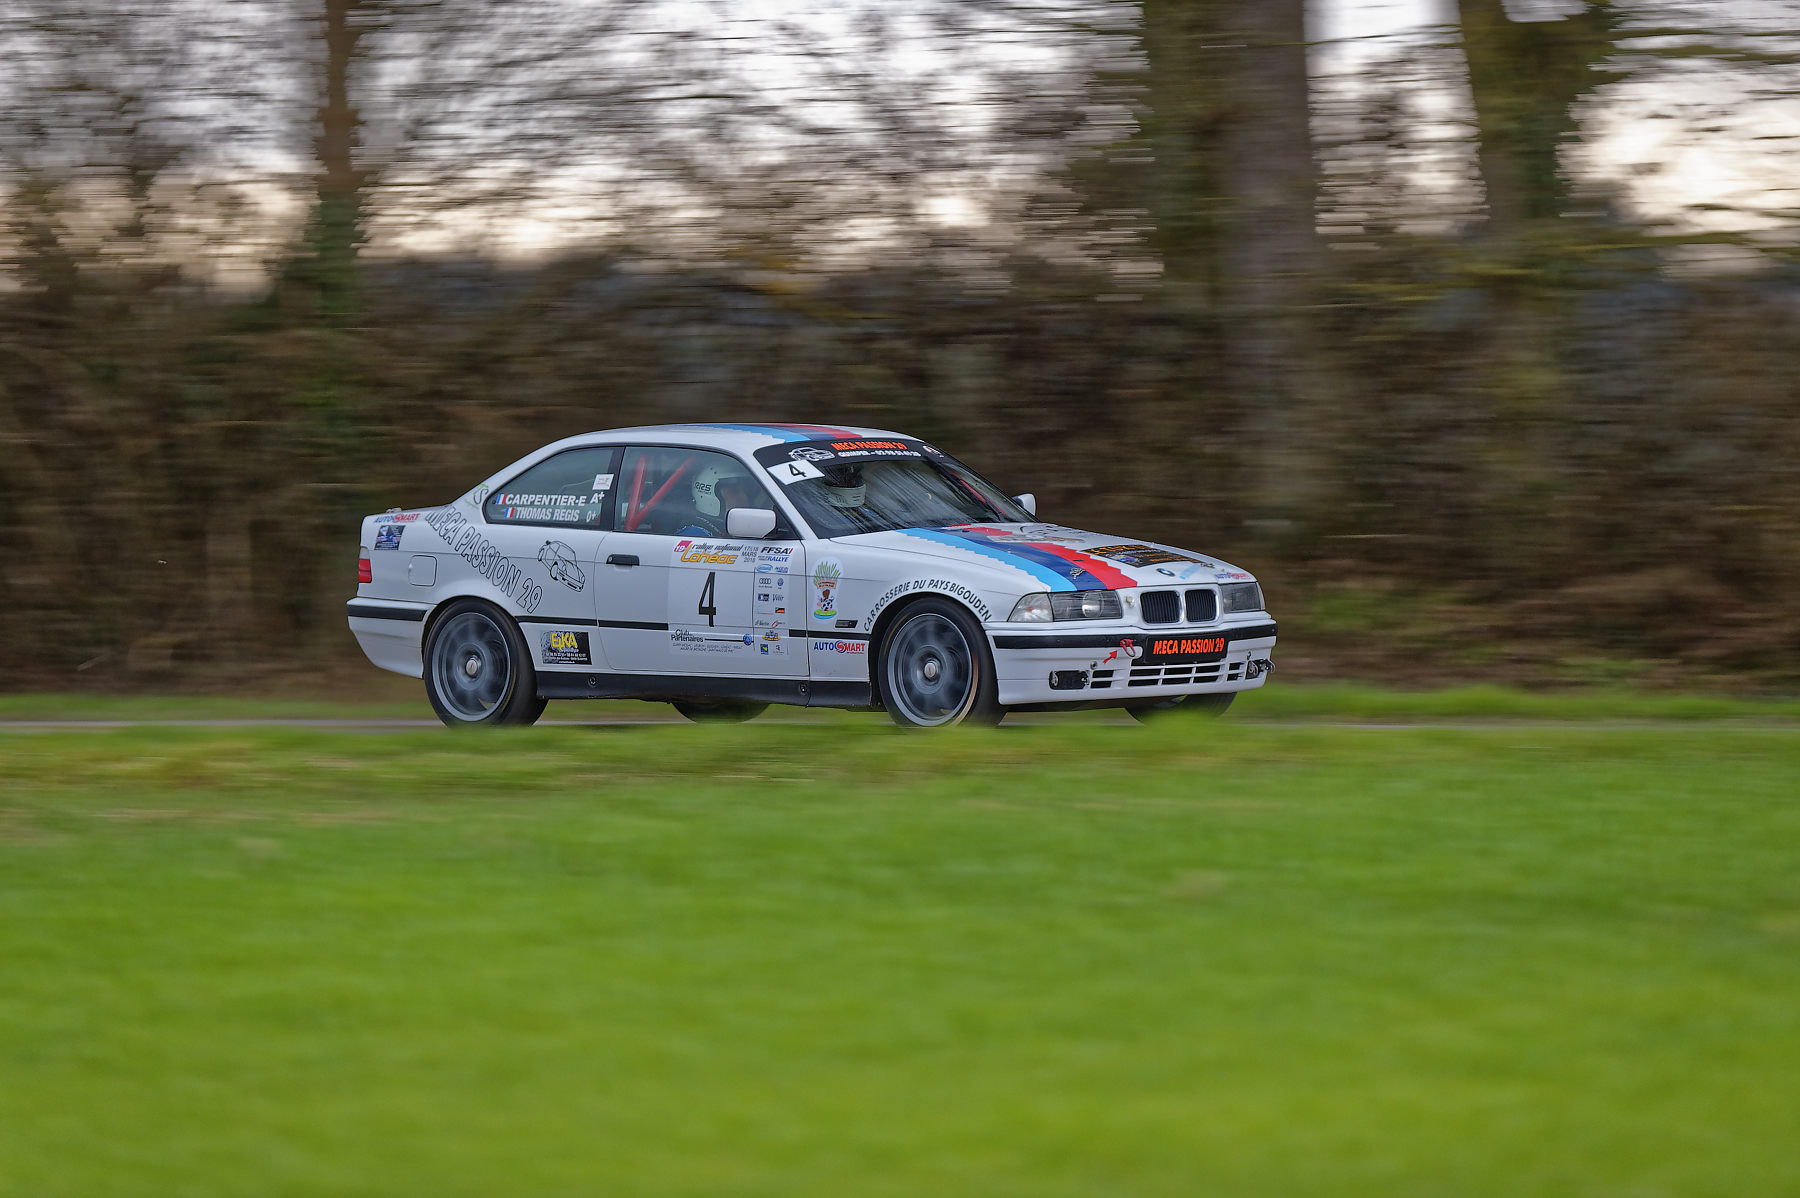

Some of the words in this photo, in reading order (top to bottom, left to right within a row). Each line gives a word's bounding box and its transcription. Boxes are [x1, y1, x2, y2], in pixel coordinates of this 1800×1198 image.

[830, 442, 860, 451] MECA
[855, 441, 897, 450] PASSION
[788, 464, 807, 478] 4
[590, 491, 605, 504] A+
[516, 507, 551, 520] THOMAS
[553, 509, 580, 521] REGIS
[760, 546, 790, 555] FFSA
[454, 526, 522, 598] PASSION
[516, 577, 543, 615] 29
[698, 571, 717, 628] 4
[863, 581, 911, 632] CARROSSERIE
[912, 579, 927, 590] DU
[1153, 640, 1179, 655] MECA
[1180, 638, 1215, 654] PASSION
[1214, 637, 1225, 652] 29
